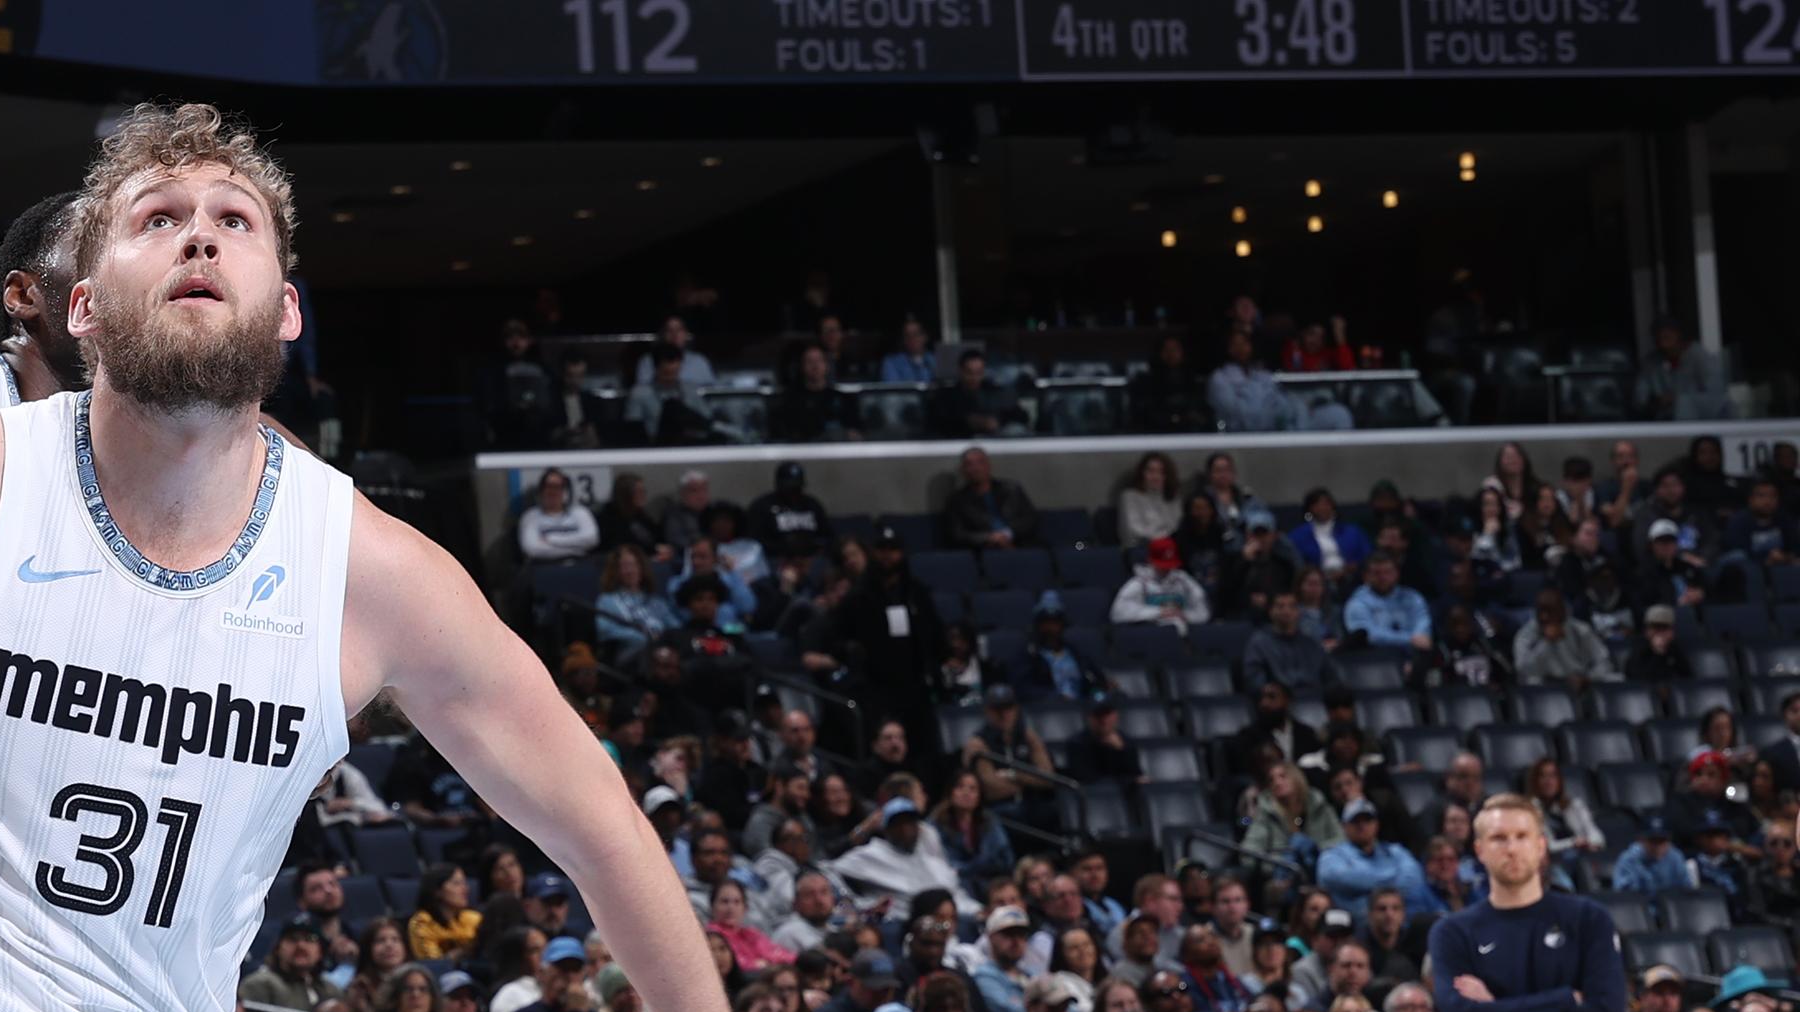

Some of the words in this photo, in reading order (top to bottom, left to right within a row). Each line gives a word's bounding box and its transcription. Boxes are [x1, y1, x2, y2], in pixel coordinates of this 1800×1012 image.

[776, 0, 970, 27] TIMEOUTS:
[980, 0, 993, 26] 1
[1051, 4, 1116, 58] 4TH
[1131, 19, 1189, 58] QTR
[1235, 0, 1357, 66] 3:48
[1425, 0, 1610, 25] TIMEOUTS:
[1618, 0, 1640, 24] 2
[1704, 0, 1800, 64] 12
[563, 0, 698, 74] 112
[776, 39, 904, 72] FOULS:
[912, 39, 927, 70] 1
[1425, 32, 1547, 64] FOULS:
[1556, 31, 1577, 62] 5
[223, 611, 305, 636] Robinhood
[35, 782, 204, 929] 31
